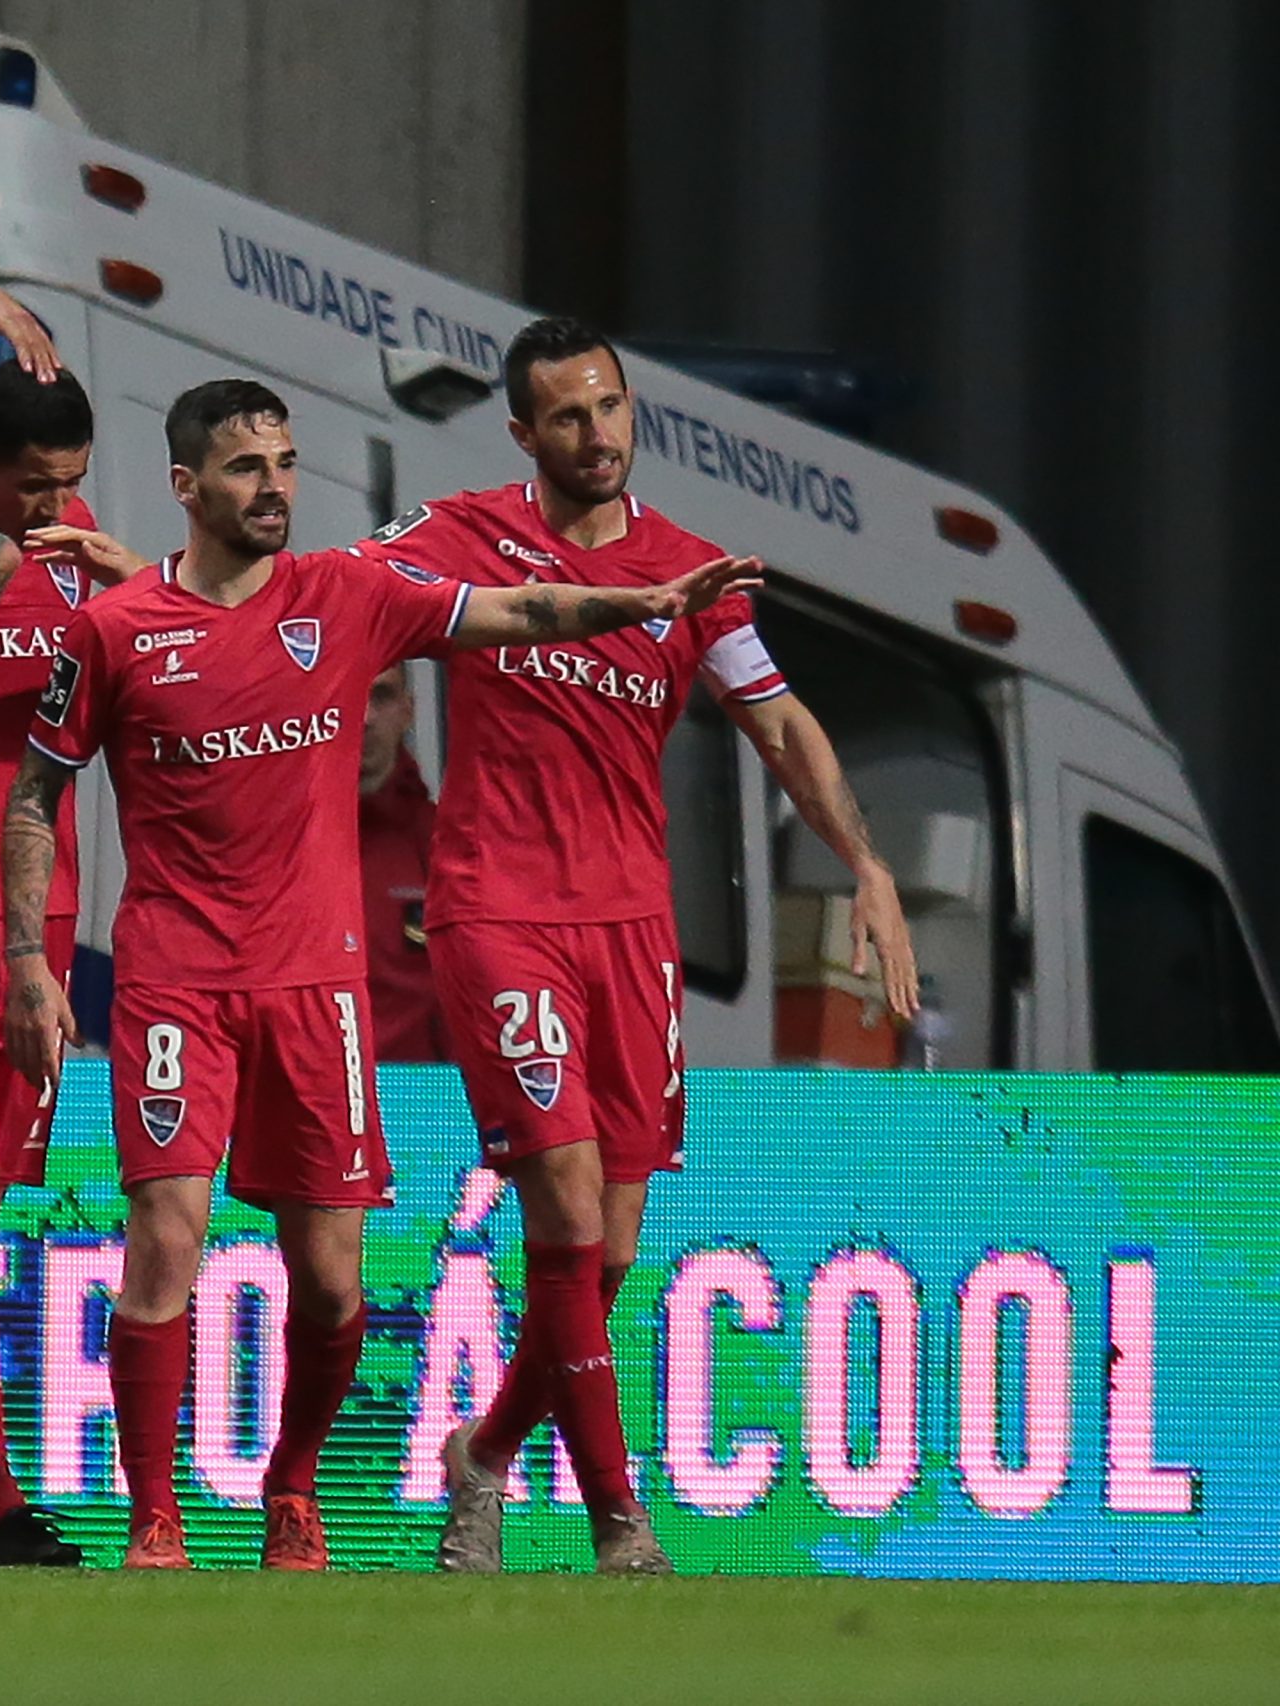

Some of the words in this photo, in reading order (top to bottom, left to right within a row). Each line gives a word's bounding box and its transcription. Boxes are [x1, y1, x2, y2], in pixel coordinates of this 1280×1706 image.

[219, 226, 401, 350] UNIDADE
[633, 396, 861, 534] NTENSIVOS
[151, 707, 341, 764] LASKASAS
[146, 1022, 183, 1091] 8
[493, 988, 569, 1058] 26
